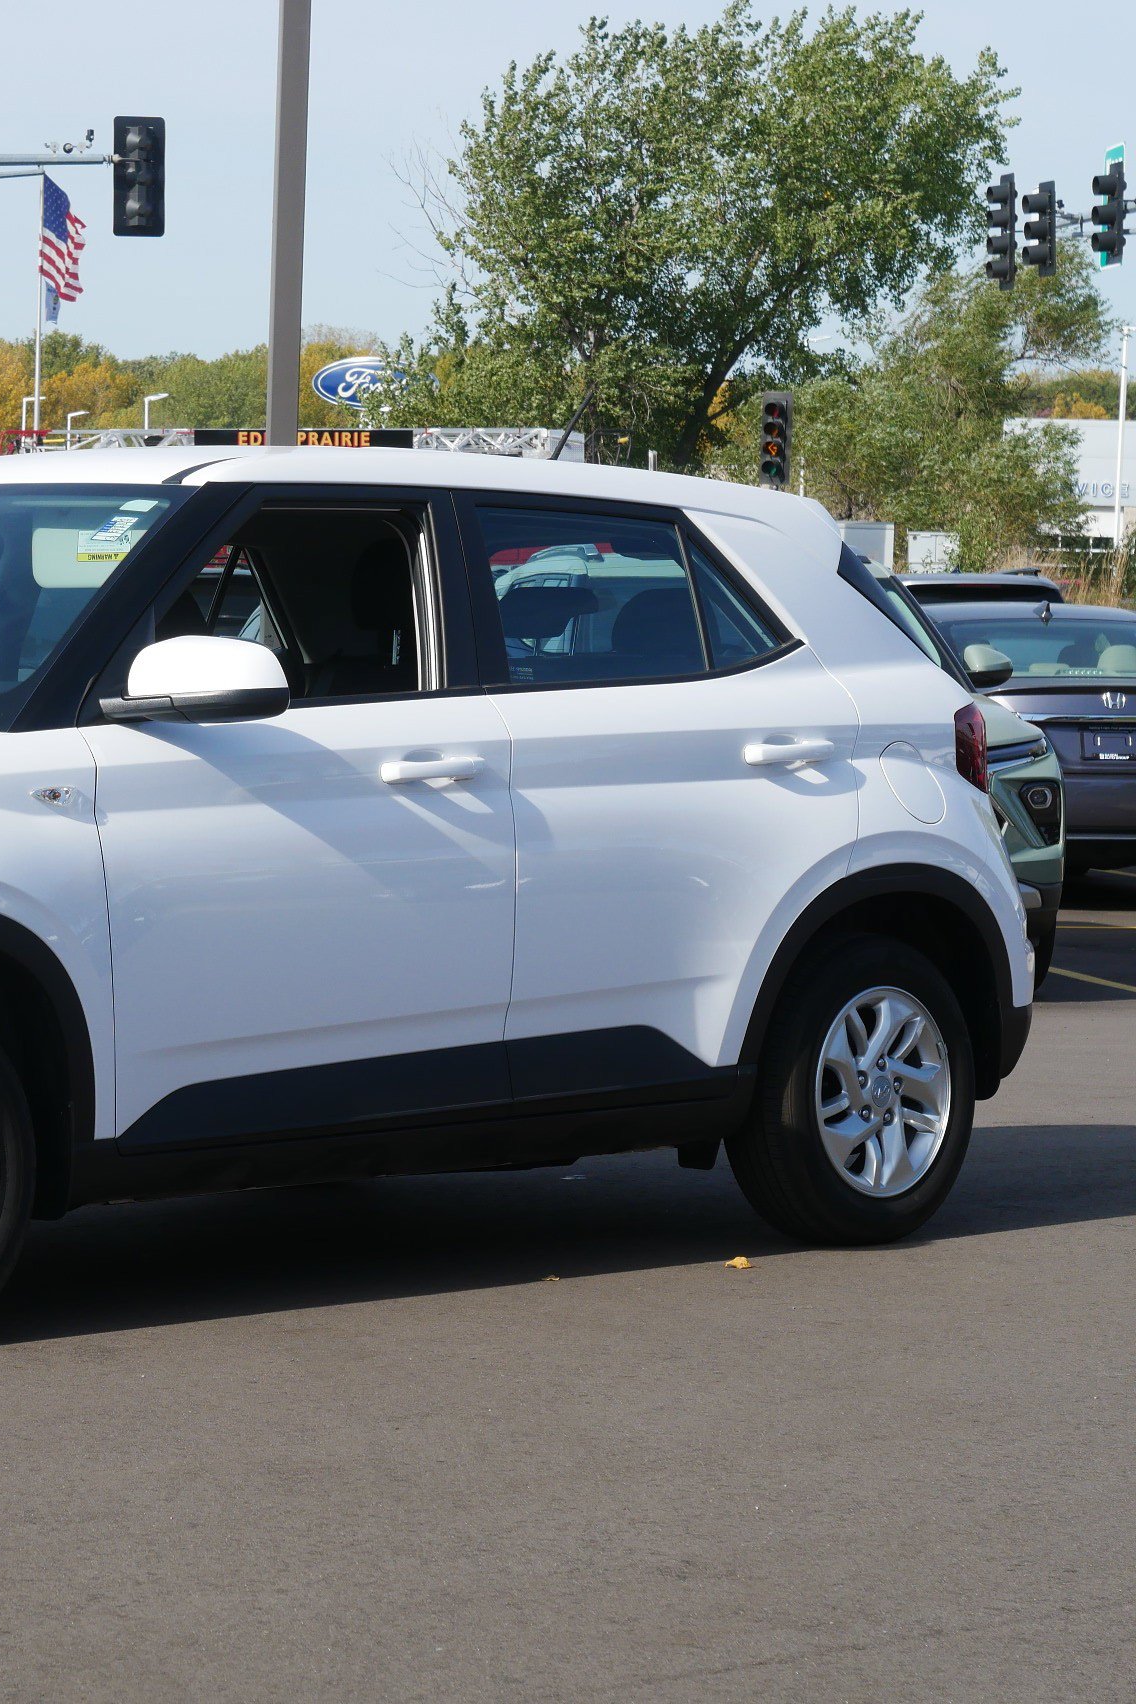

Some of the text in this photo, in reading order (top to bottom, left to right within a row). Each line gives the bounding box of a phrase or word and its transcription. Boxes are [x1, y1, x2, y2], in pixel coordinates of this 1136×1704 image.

[237, 431, 371, 447] ED PRAIRIE
[87, 553, 113, 561] WARNING
